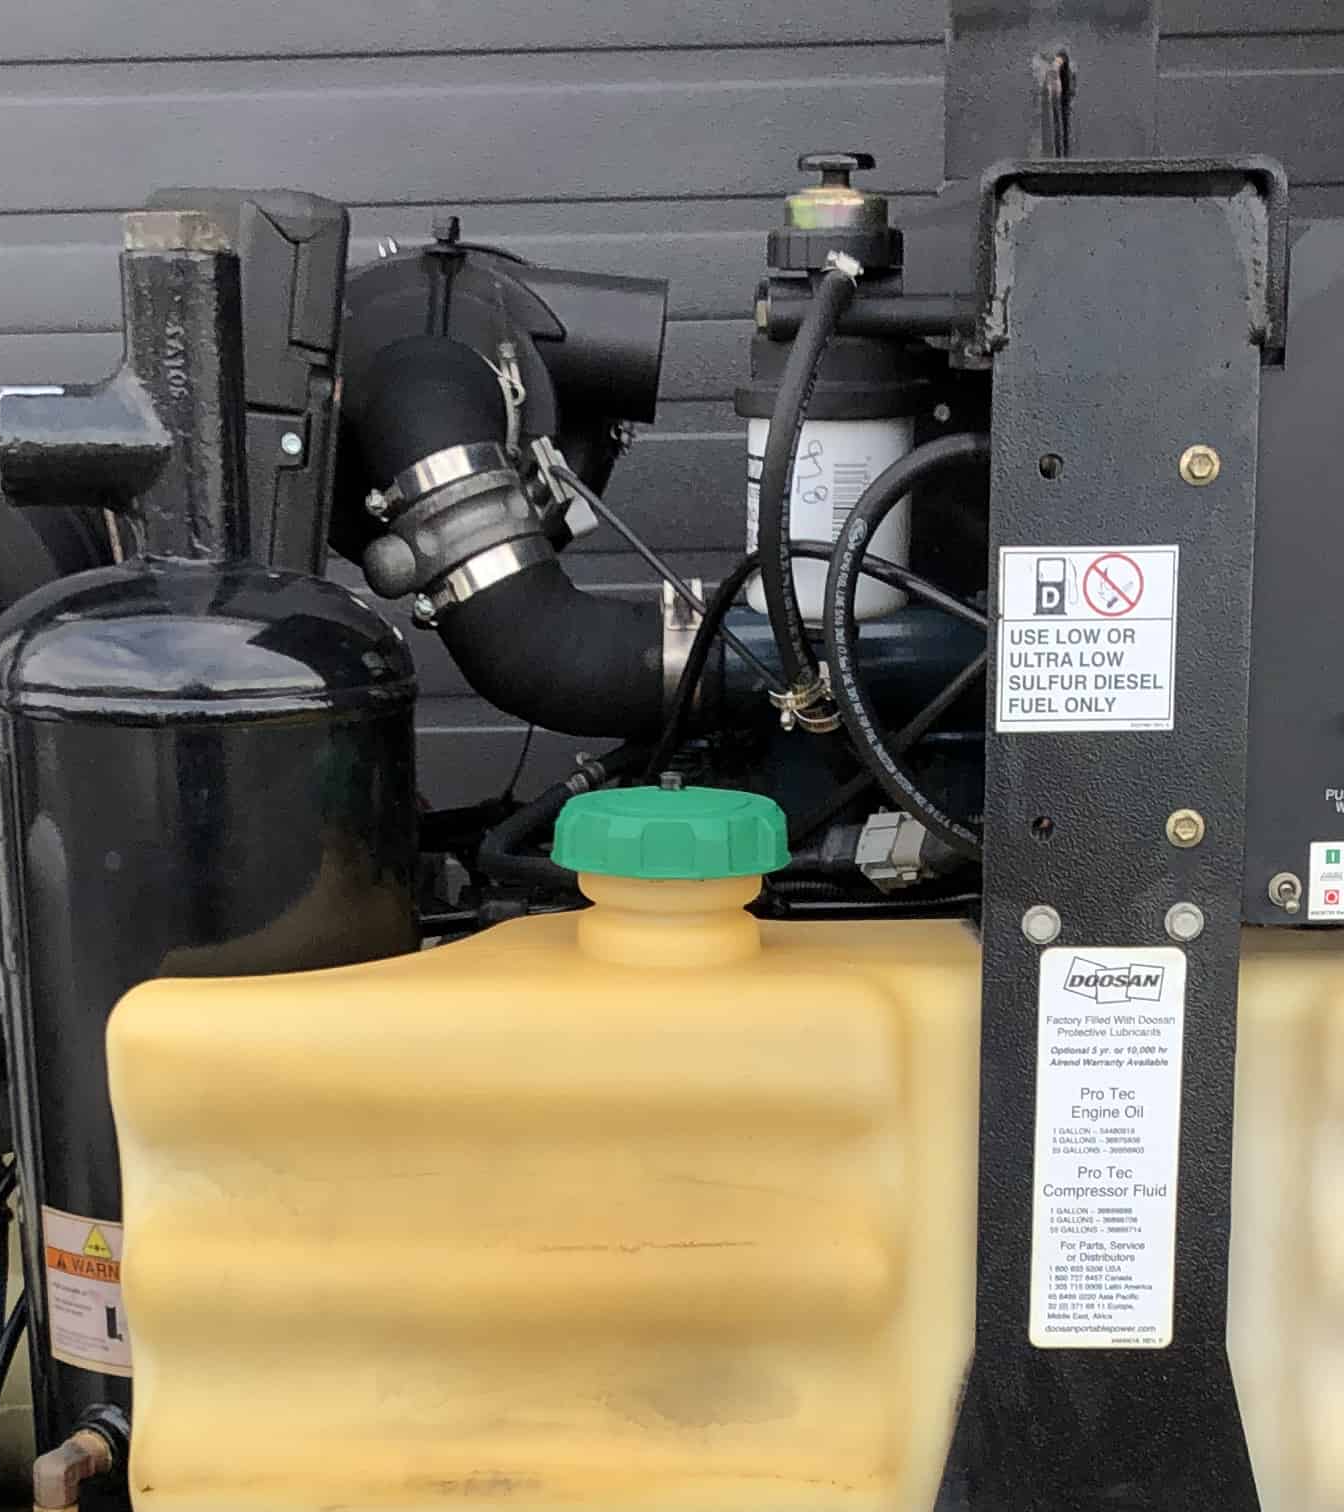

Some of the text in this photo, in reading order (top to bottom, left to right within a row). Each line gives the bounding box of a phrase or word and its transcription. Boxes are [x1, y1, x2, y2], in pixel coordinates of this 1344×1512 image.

[1042, 587, 1060, 608] D
[1010, 628, 1136, 644] USE LOW OR
[1010, 652, 1124, 667] ULTRA LOW
[1009, 674, 1163, 690] SULFUR DIESEL
[1009, 697, 1116, 713] FUEL ONLY
[1069, 975, 1159, 987] DOOSAN
[1047, 1016, 1175, 1026] Factory Filled With Doosan
[1057, 1028, 1161, 1036] Protective Lubricants
[1051, 1047, 1090, 1055] Optional
[1100, 1048, 1112, 1056] yr.
[1083, 1059, 1124, 1068] Warranty
[1081, 1088, 1135, 1100] Pro Tec
[1072, 1106, 1143, 1121] Engine Oil
[1078, 1167, 1133, 1179] Pro Tec
[1043, 1184, 1167, 1200] Compressor Fluid
[1080, 1242, 1106, 1251] Parts,
[1111, 1242, 1145, 1250] Service
[1080, 1253, 1135, 1262] Distributors
[71, 1257, 120, 1280] WARN
[1045, 1325, 1156, 1334] doosanportablepower.com
